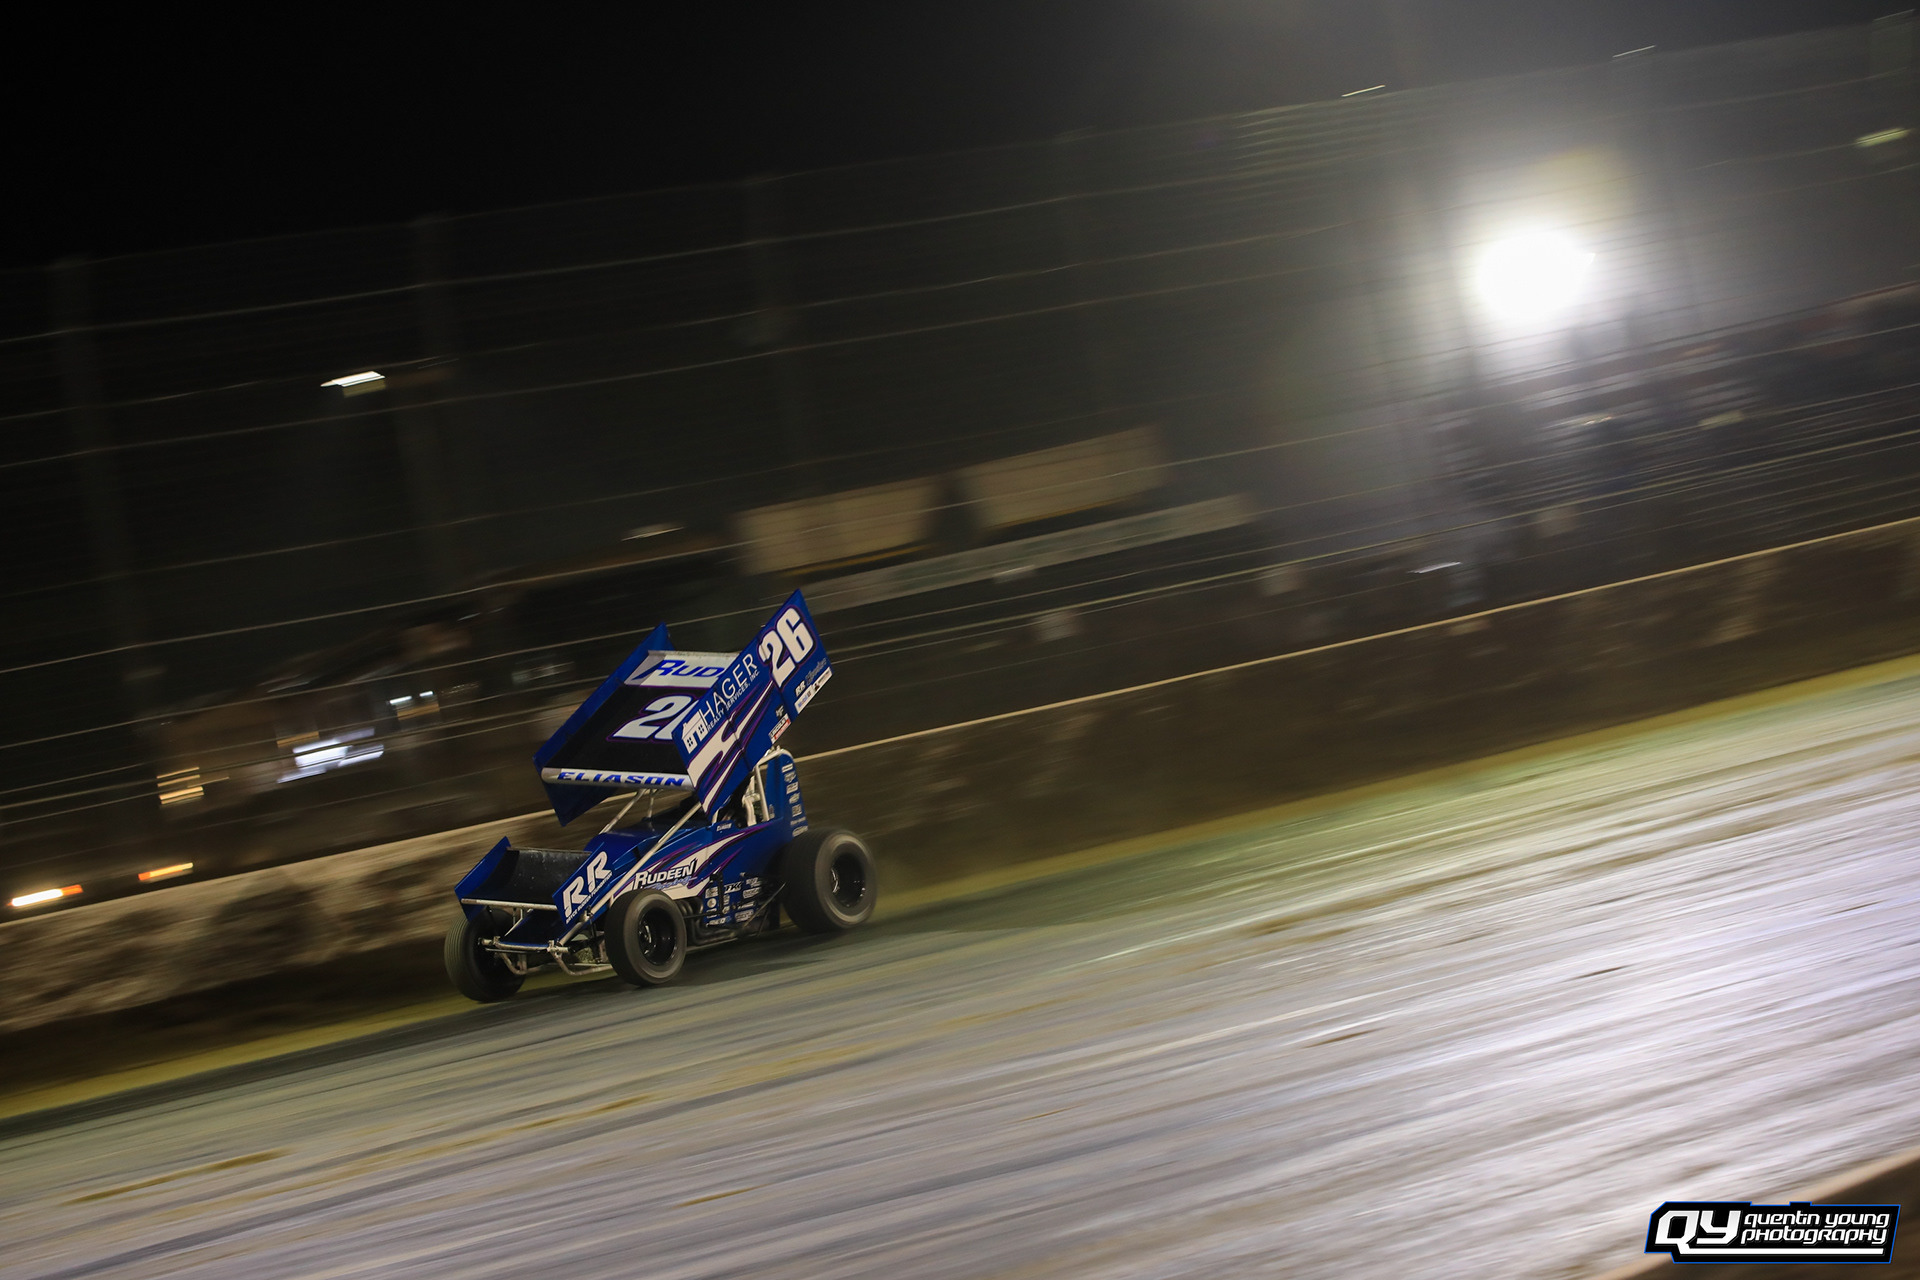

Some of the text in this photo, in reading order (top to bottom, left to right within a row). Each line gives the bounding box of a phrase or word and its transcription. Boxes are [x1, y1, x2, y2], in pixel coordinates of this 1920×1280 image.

[758, 607, 814, 688] 26
[699, 653, 758, 726] HAGER
[706, 708, 725, 731] REALTY
[557, 771, 686, 787] ELIASON
[563, 851, 612, 918] RR
[633, 858, 697, 890] RUDEEN
